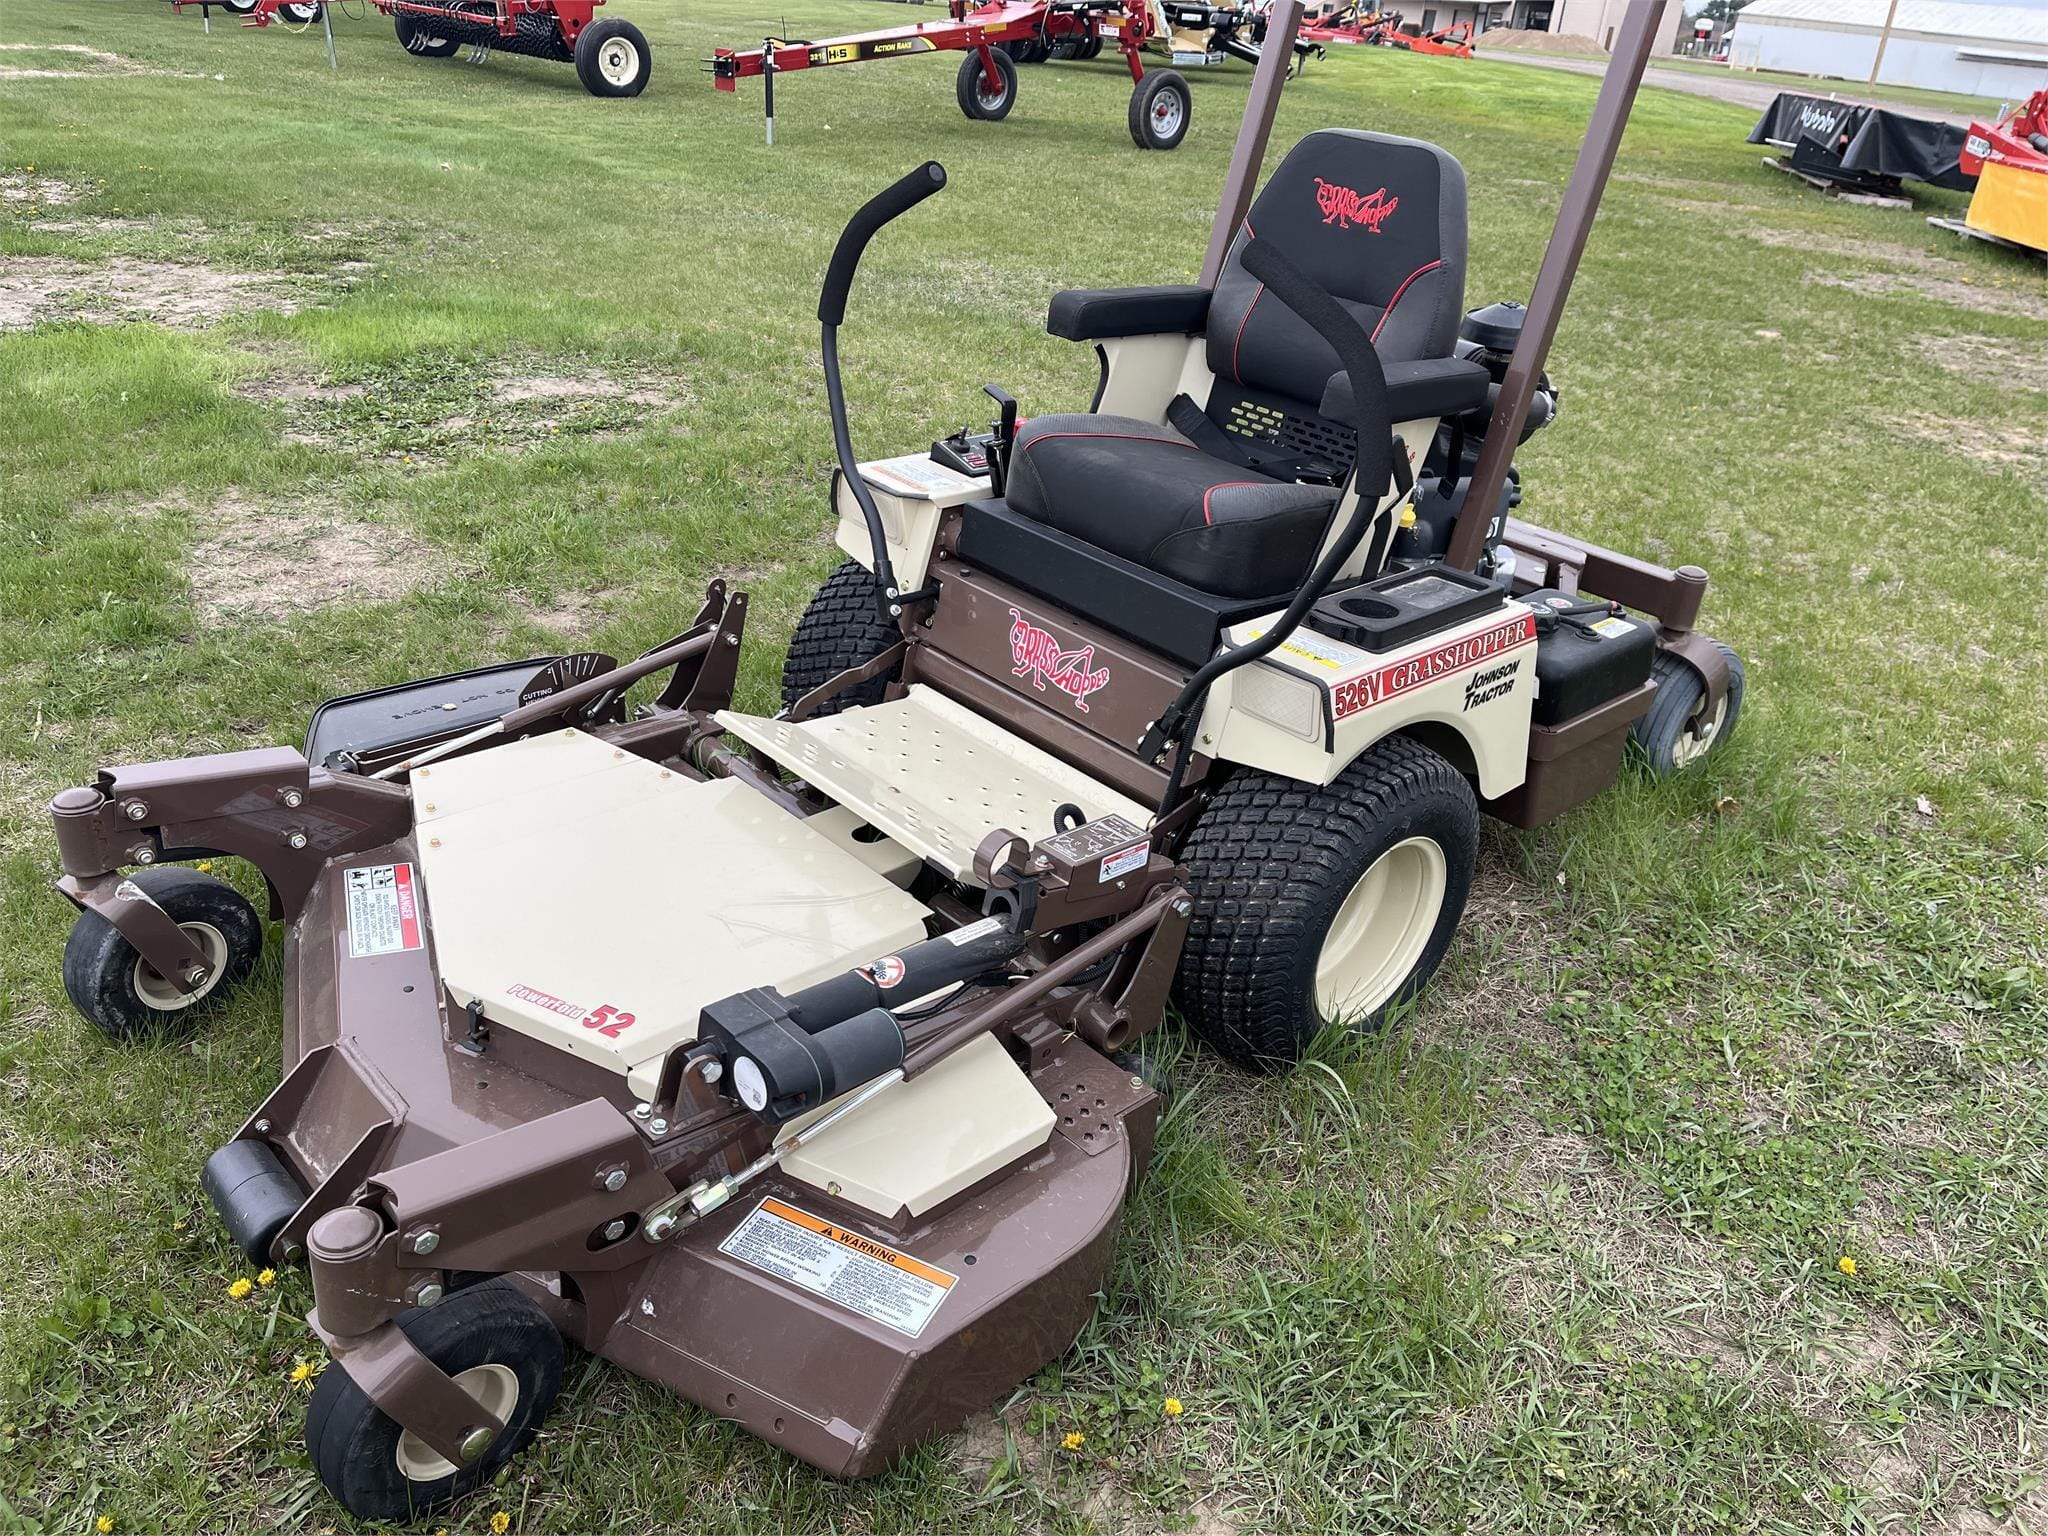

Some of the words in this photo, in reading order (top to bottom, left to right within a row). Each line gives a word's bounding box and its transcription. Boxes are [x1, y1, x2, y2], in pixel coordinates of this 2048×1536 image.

[874, 44, 896, 53] ACTION
[1009, 617, 1110, 700] GRASSHOPPER
[1335, 671, 1382, 717] 526V
[1391, 620, 1527, 690] GRASSHOPPER
[1465, 659, 1521, 694] JOHNSON
[523, 687, 553, 701] CUTTING
[1463, 679, 1515, 713] TRACTOR
[399, 890, 414, 920] DANGER
[507, 983, 586, 1020] PowerFold
[582, 1004, 637, 1039] 52
[838, 1233, 897, 1263] WARNING
